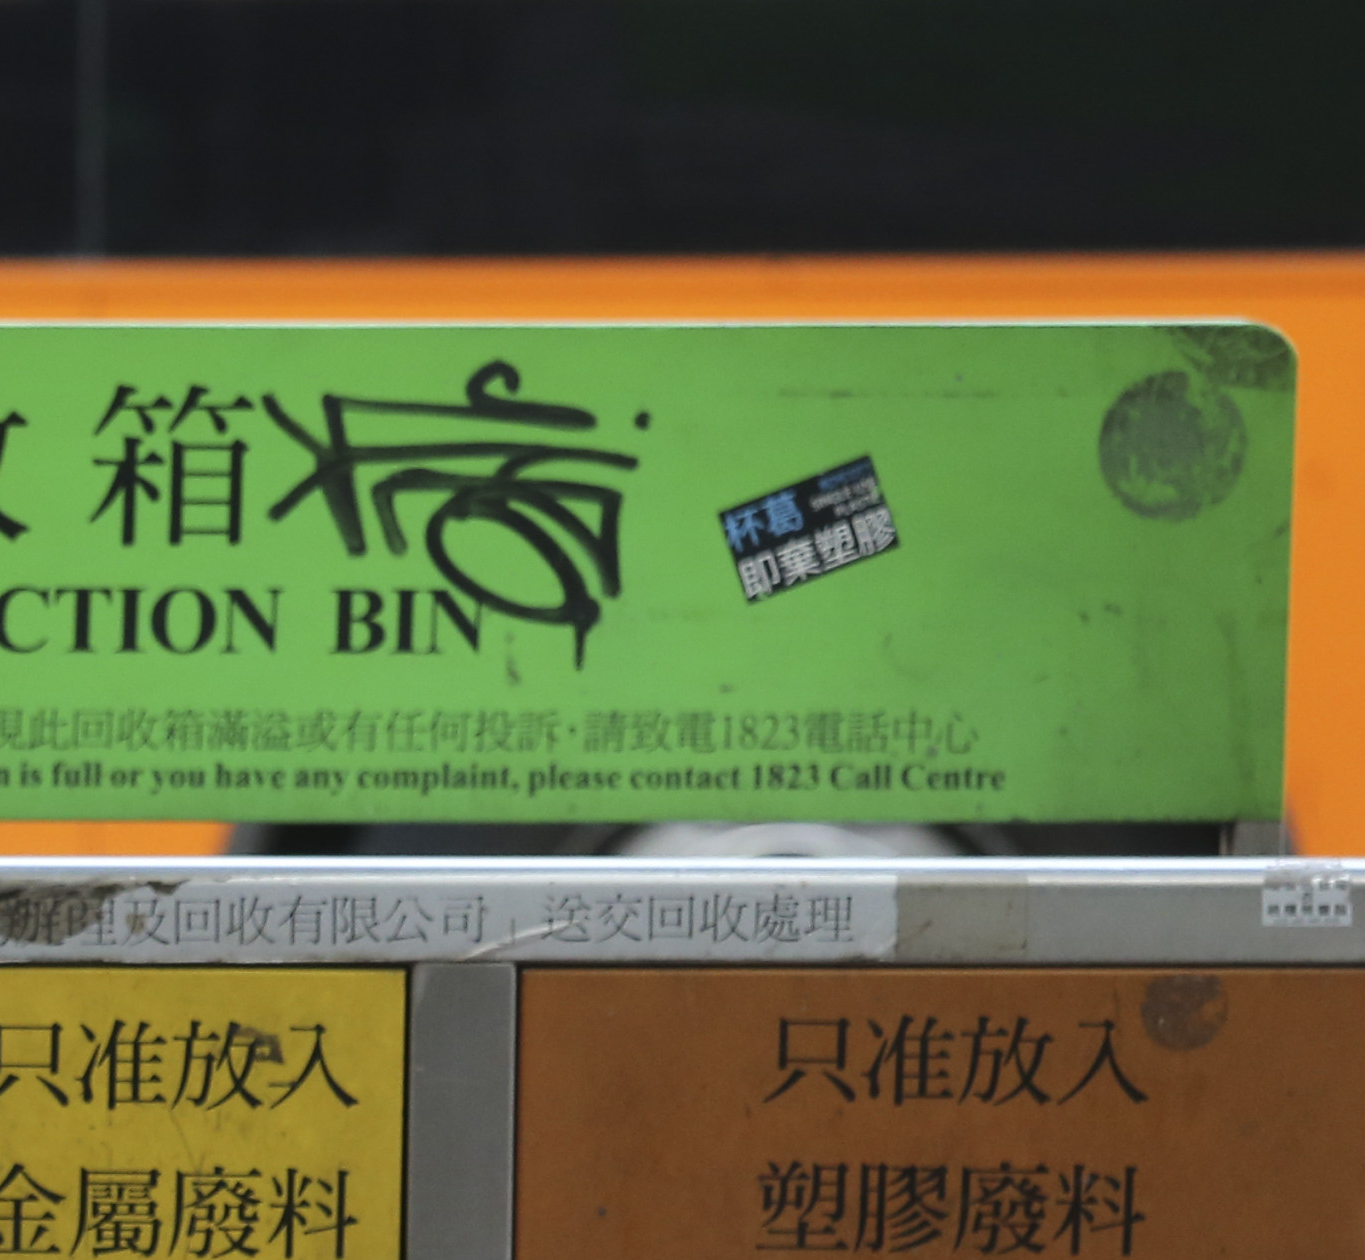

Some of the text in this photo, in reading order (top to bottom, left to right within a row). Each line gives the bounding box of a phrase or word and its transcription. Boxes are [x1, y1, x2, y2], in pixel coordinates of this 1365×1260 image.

[333, 586, 482, 657] BIN
[19, 759, 41, 790] is
[52, 759, 104, 790] full
[109, 759, 143, 790] or
[149, 759, 205, 795] you
[215, 759, 282, 790] have
[294, 759, 345, 795] any
[358, 762, 520, 796] complaint,
[528, 763, 623, 798] please
[629, 763, 741, 792] contact
[751, 763, 819, 792] 1823
[829, 763, 892, 792] Call
[901, 763, 1006, 792] Centre
[761, 1015, 1149, 1108] 只准放入
[755, 1160, 1147, 1258] 塑膠廢料
